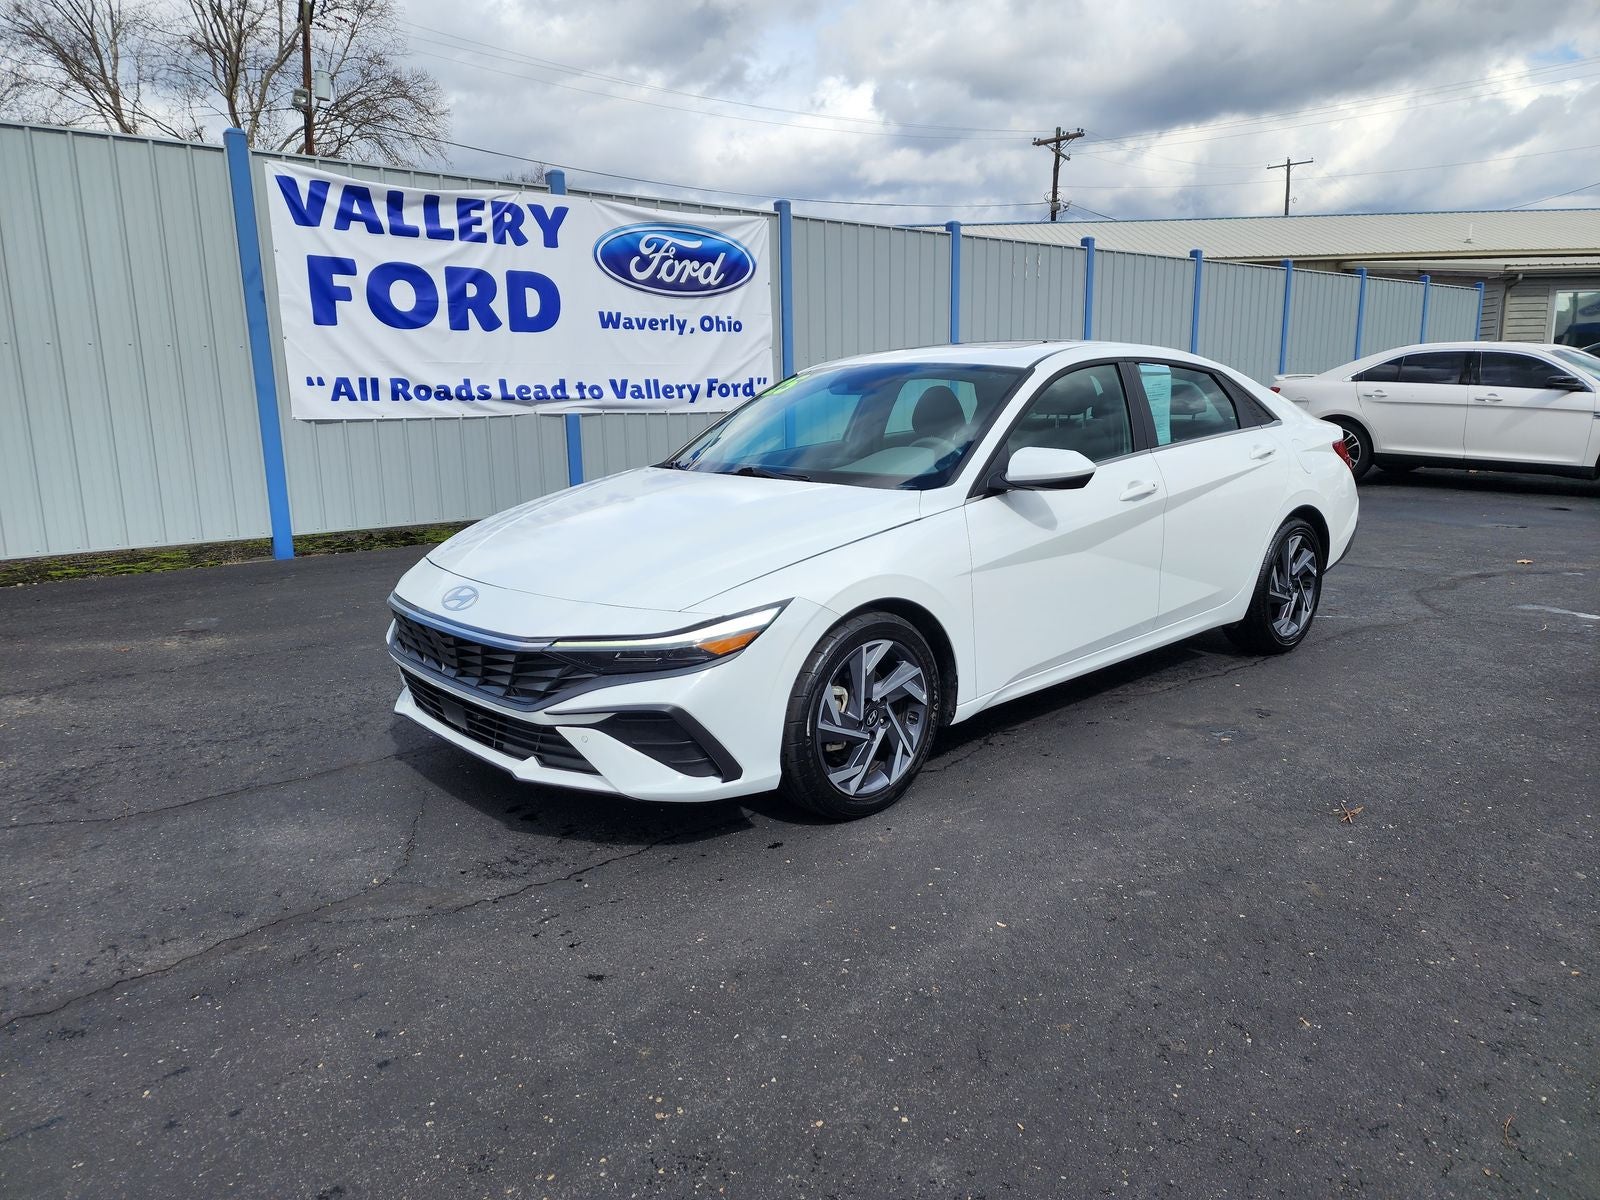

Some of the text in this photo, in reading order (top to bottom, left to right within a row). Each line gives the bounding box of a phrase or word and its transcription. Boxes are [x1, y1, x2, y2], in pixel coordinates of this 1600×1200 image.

[275, 174, 570, 249] VALLERY
[630, 233, 726, 286] Ford
[306, 254, 561, 334] FORD
[598, 310, 743, 336] Waverly, Ohio
[389, 377, 493, 402] Roads
[498, 378, 570, 402] Lead
[575, 381, 604, 401] to
[609, 378, 701, 404] Vallery
